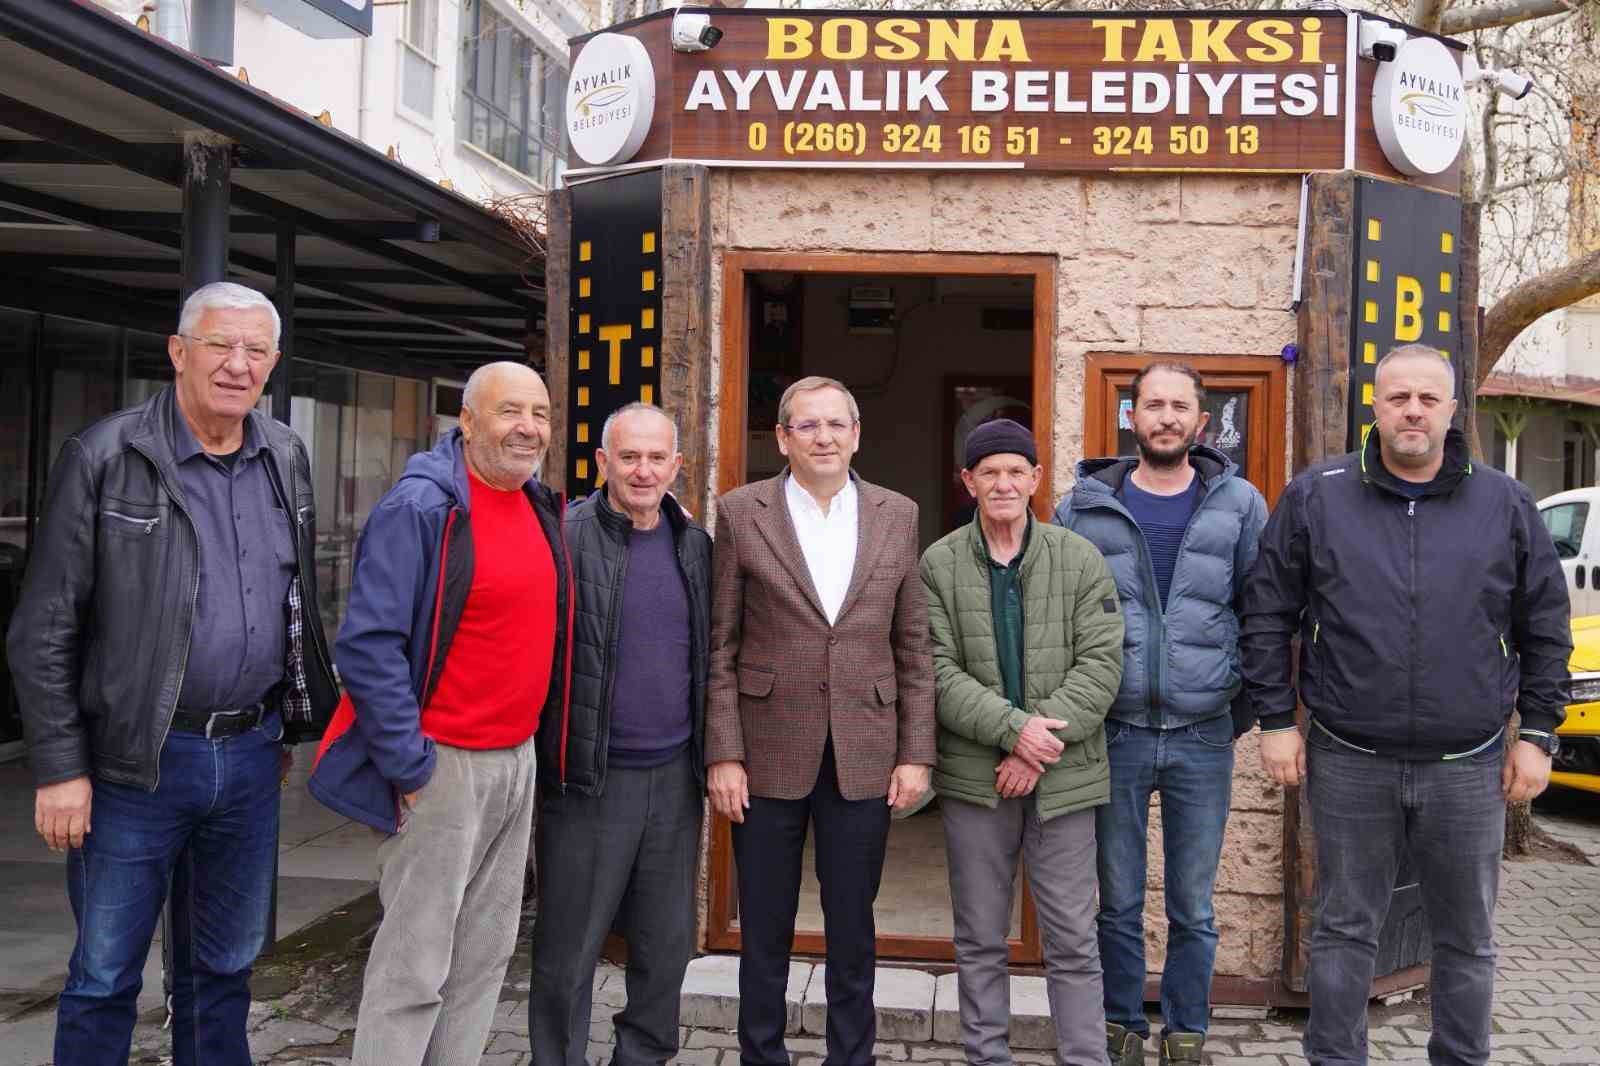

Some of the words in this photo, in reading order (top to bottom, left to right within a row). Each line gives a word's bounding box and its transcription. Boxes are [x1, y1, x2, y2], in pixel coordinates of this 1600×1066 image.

[765, 18, 1033, 62] BOSNA
[574, 64, 632, 95] AYVALIK
[683, 69, 950, 112] AYVALIK
[970, 63, 1339, 116] BELEDİYESİ
[1399, 71, 1460, 101] AYVALIK
[748, 121, 768, 152] 0
[783, 121, 867, 156] (266)
[882, 123, 942, 153] 324
[957, 125, 991, 155] 16
[1005, 126, 1039, 156] 51
[1092, 125, 1154, 156] 324
[1169, 125, 1209, 155] 50
[1224, 124, 1259, 155] 13
